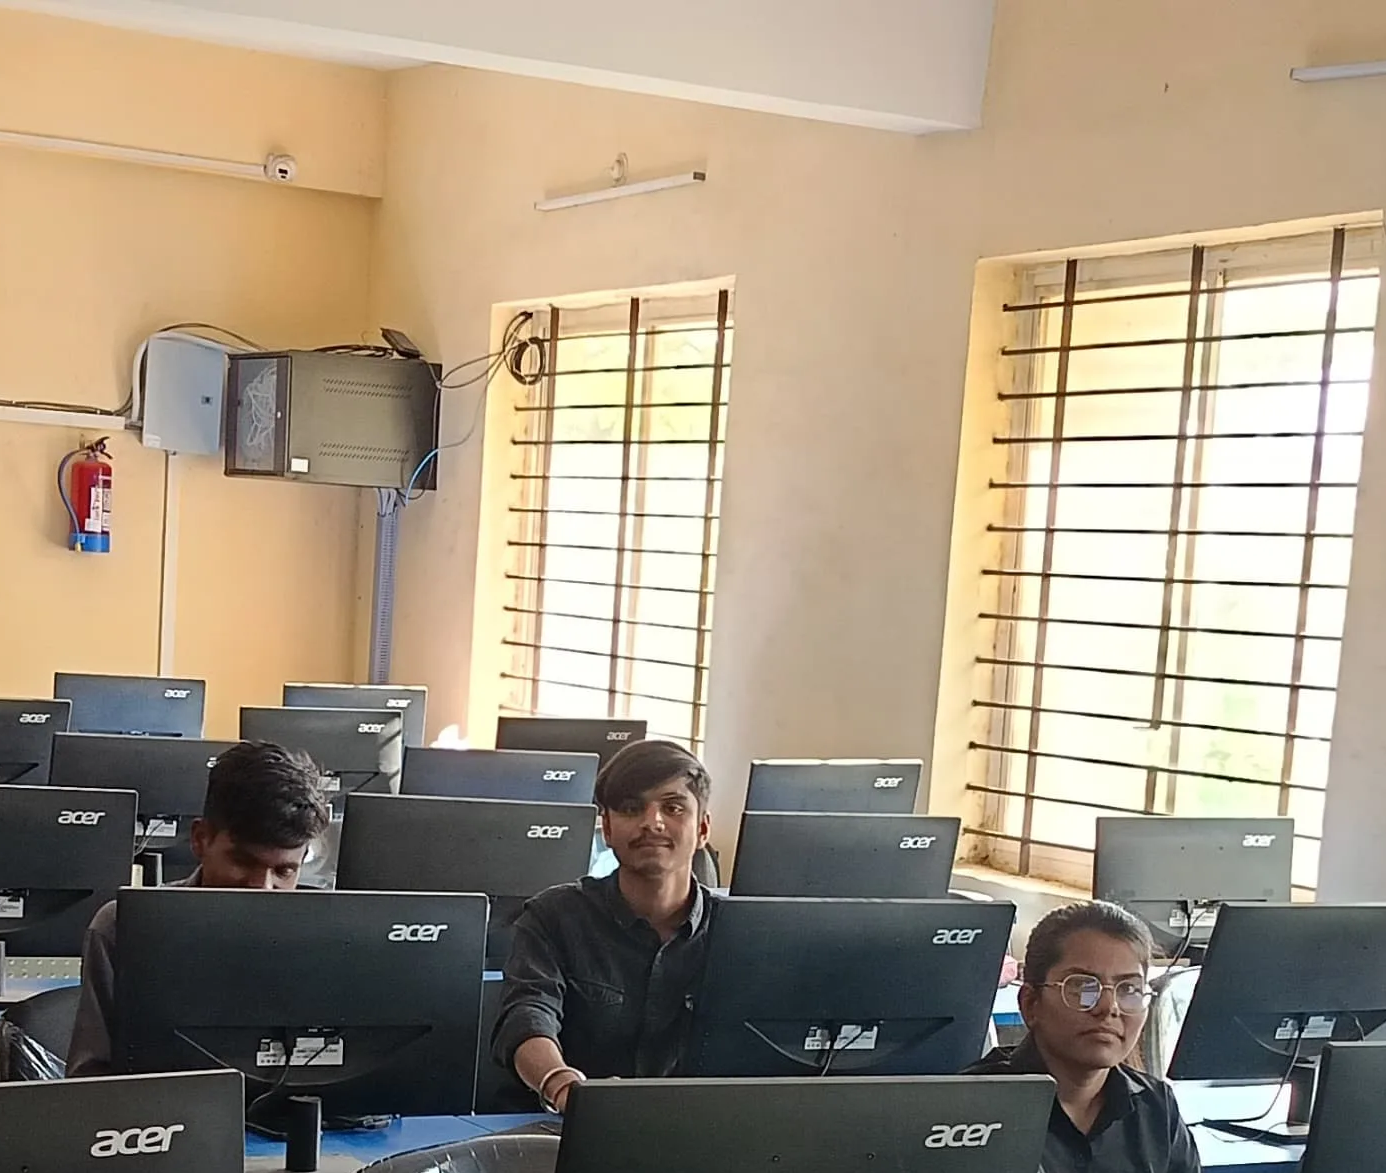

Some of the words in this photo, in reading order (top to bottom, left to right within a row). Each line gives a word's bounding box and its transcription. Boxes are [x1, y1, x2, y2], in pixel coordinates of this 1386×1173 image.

[387, 699, 411, 707] acer
[20, 714, 50, 722] acer
[358, 724, 385, 734] acer
[607, 731, 631, 741] acer
[544, 771, 575, 780] acer
[875, 778, 902, 787] acer
[58, 811, 105, 824] acer
[528, 826, 568, 838] acer
[900, 837, 936, 848] acer
[1243, 835, 1275, 846] acer
[388, 925, 447, 941] acer
[933, 929, 982, 943] acer
[91, 1125, 184, 1156] acer
[925, 1123, 1002, 1147] acer
